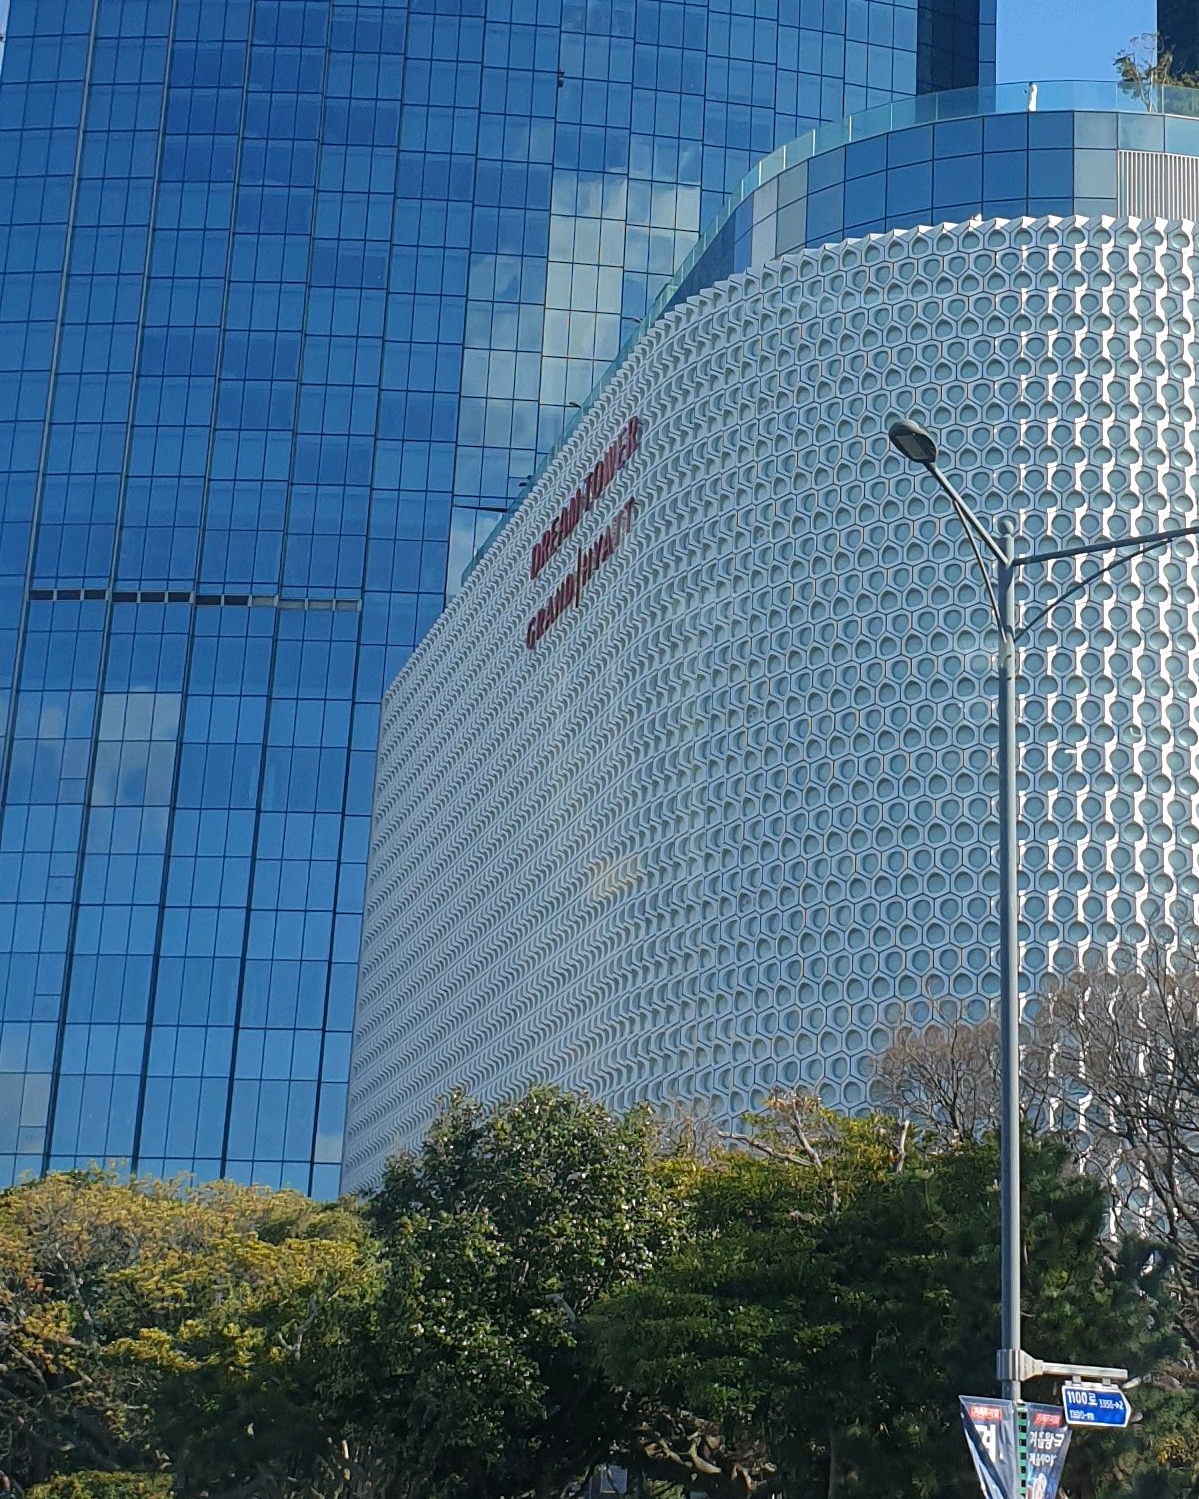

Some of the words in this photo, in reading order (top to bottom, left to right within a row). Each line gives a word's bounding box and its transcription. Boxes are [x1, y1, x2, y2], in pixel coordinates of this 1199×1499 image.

[527, 572, 574, 650] GRAND
[579, 496, 635, 587] HYATT
[531, 487, 582, 581] DREAM
[584, 415, 639, 512] TOWER
[1067, 1390, 1098, 1406] 1100로
